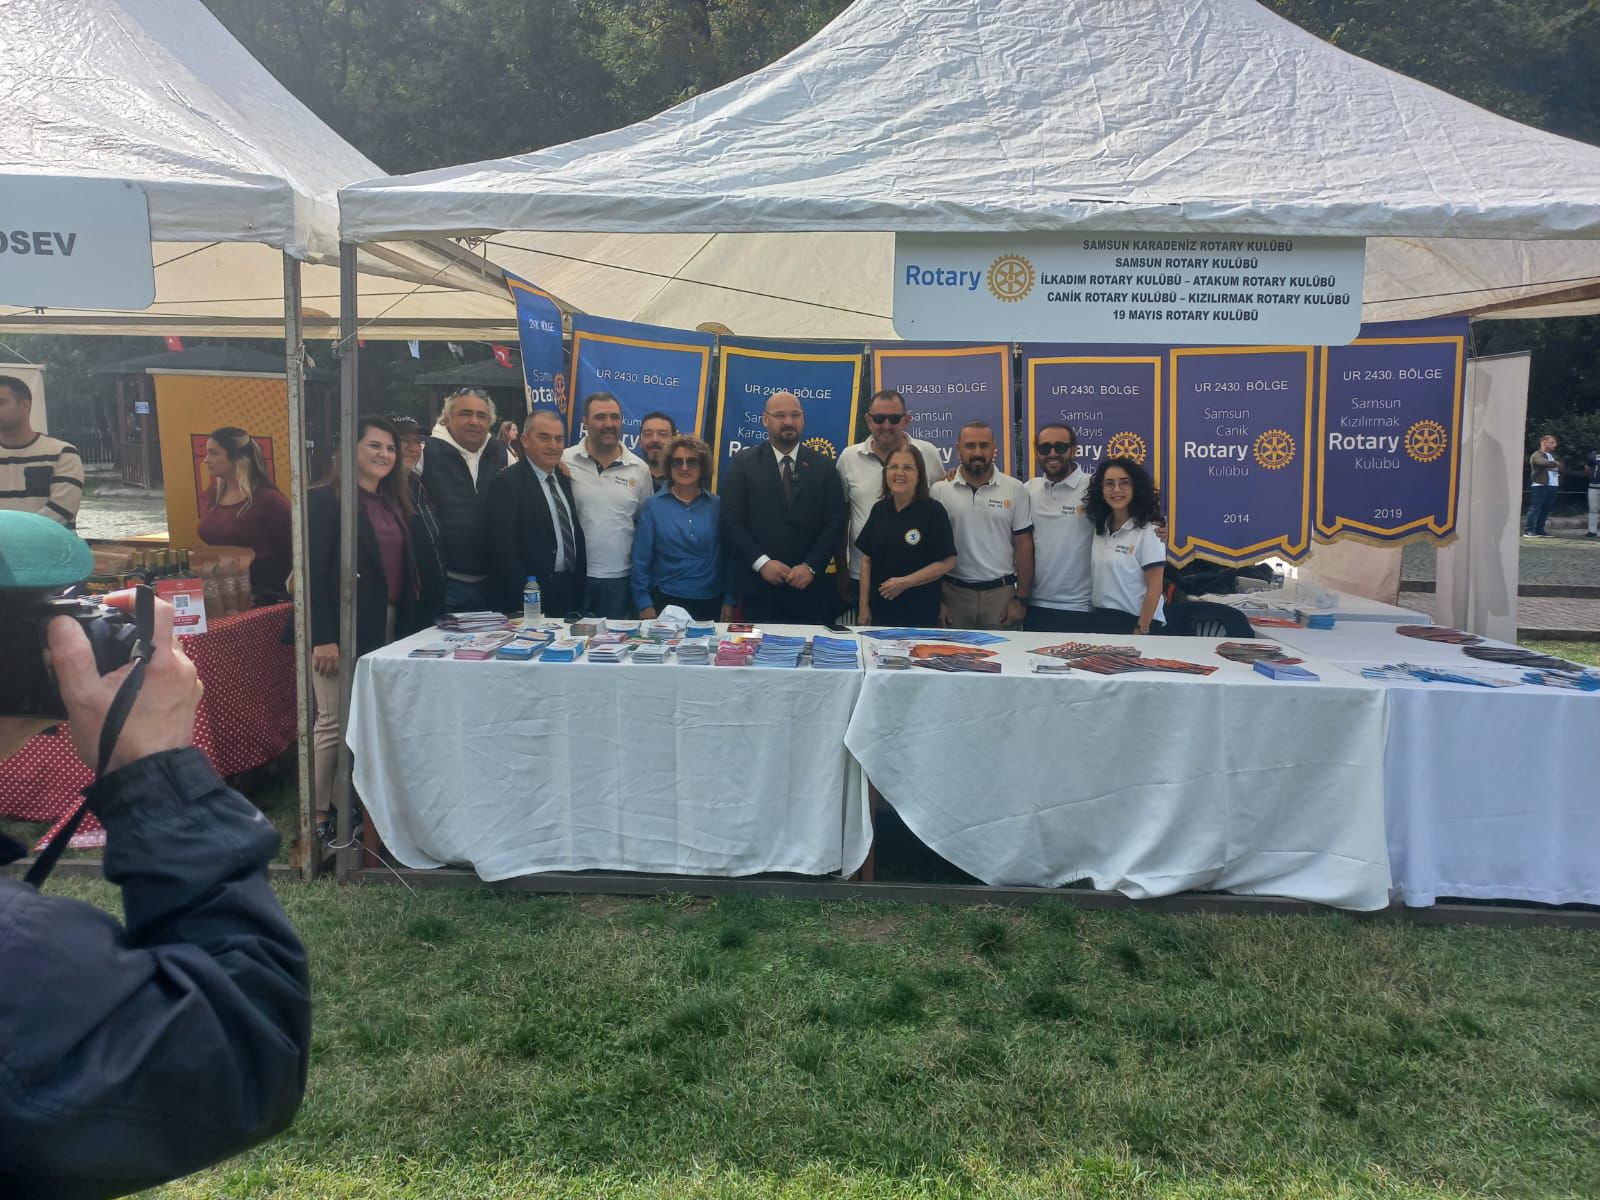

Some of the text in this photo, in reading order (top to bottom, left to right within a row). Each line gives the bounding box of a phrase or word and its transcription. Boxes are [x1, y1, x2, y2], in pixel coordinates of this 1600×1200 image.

[1083, 239, 1293, 252] SAMSUN KARADENİZ ROTARY KULÜBÜ
[1115, 257, 1258, 269] SAMSUN ROTARY KULÜBÜ
[905, 264, 981, 291] Rotary
[1041, 273, 1087, 285] İLKADIM
[1090, 275, 1133, 285] ROTARY
[1136, 273, 1181, 286] KULÜBÜ
[1193, 275, 1239, 286] ATAKUM
[1242, 276, 1287, 287] ROTARY
[1289, 275, 1336, 287] KULÜBÜ
[1047, 291, 1082, 302] CANİK
[1085, 292, 1128, 302] ROTARY
[1131, 291, 1177, 303] KULÜBÜ
[1188, 293, 1253, 303] KIZILIRMAK
[1256, 294, 1301, 304] ROTARY
[1304, 293, 1350, 305] KULÜBÜ
[1113, 309, 1258, 321] 19 MAYIS ROTARY KULÜBÜ
[596, 369, 680, 387] UR 2430. BÖLGE
[1343, 368, 1442, 381] UR 2430. BÖLGE
[745, 384, 760, 394] UR
[793, 387, 832, 399] BÖLGE
[896, 381, 989, 394] UR 2430. BÖLGE
[1052, 384, 1140, 395] UR 2430. BÖLGE
[1195, 380, 1289, 392] UR 2430. BÖLGE
[1351, 397, 1401, 410] Samsun
[1060, 409, 1103, 421] Samsun
[1204, 407, 1250, 420] Samsun
[1340, 415, 1400, 428] Kızılırmak
[1216, 425, 1249, 437] Canik
[1329, 432, 1400, 453] Rotary
[1184, 441, 1249, 462] Rotary
[1355, 457, 1400, 470] Kulübü
[1208, 465, 1249, 477] Kulübü
[1223, 513, 1250, 523] 2014
[1374, 508, 1402, 519] 2019
